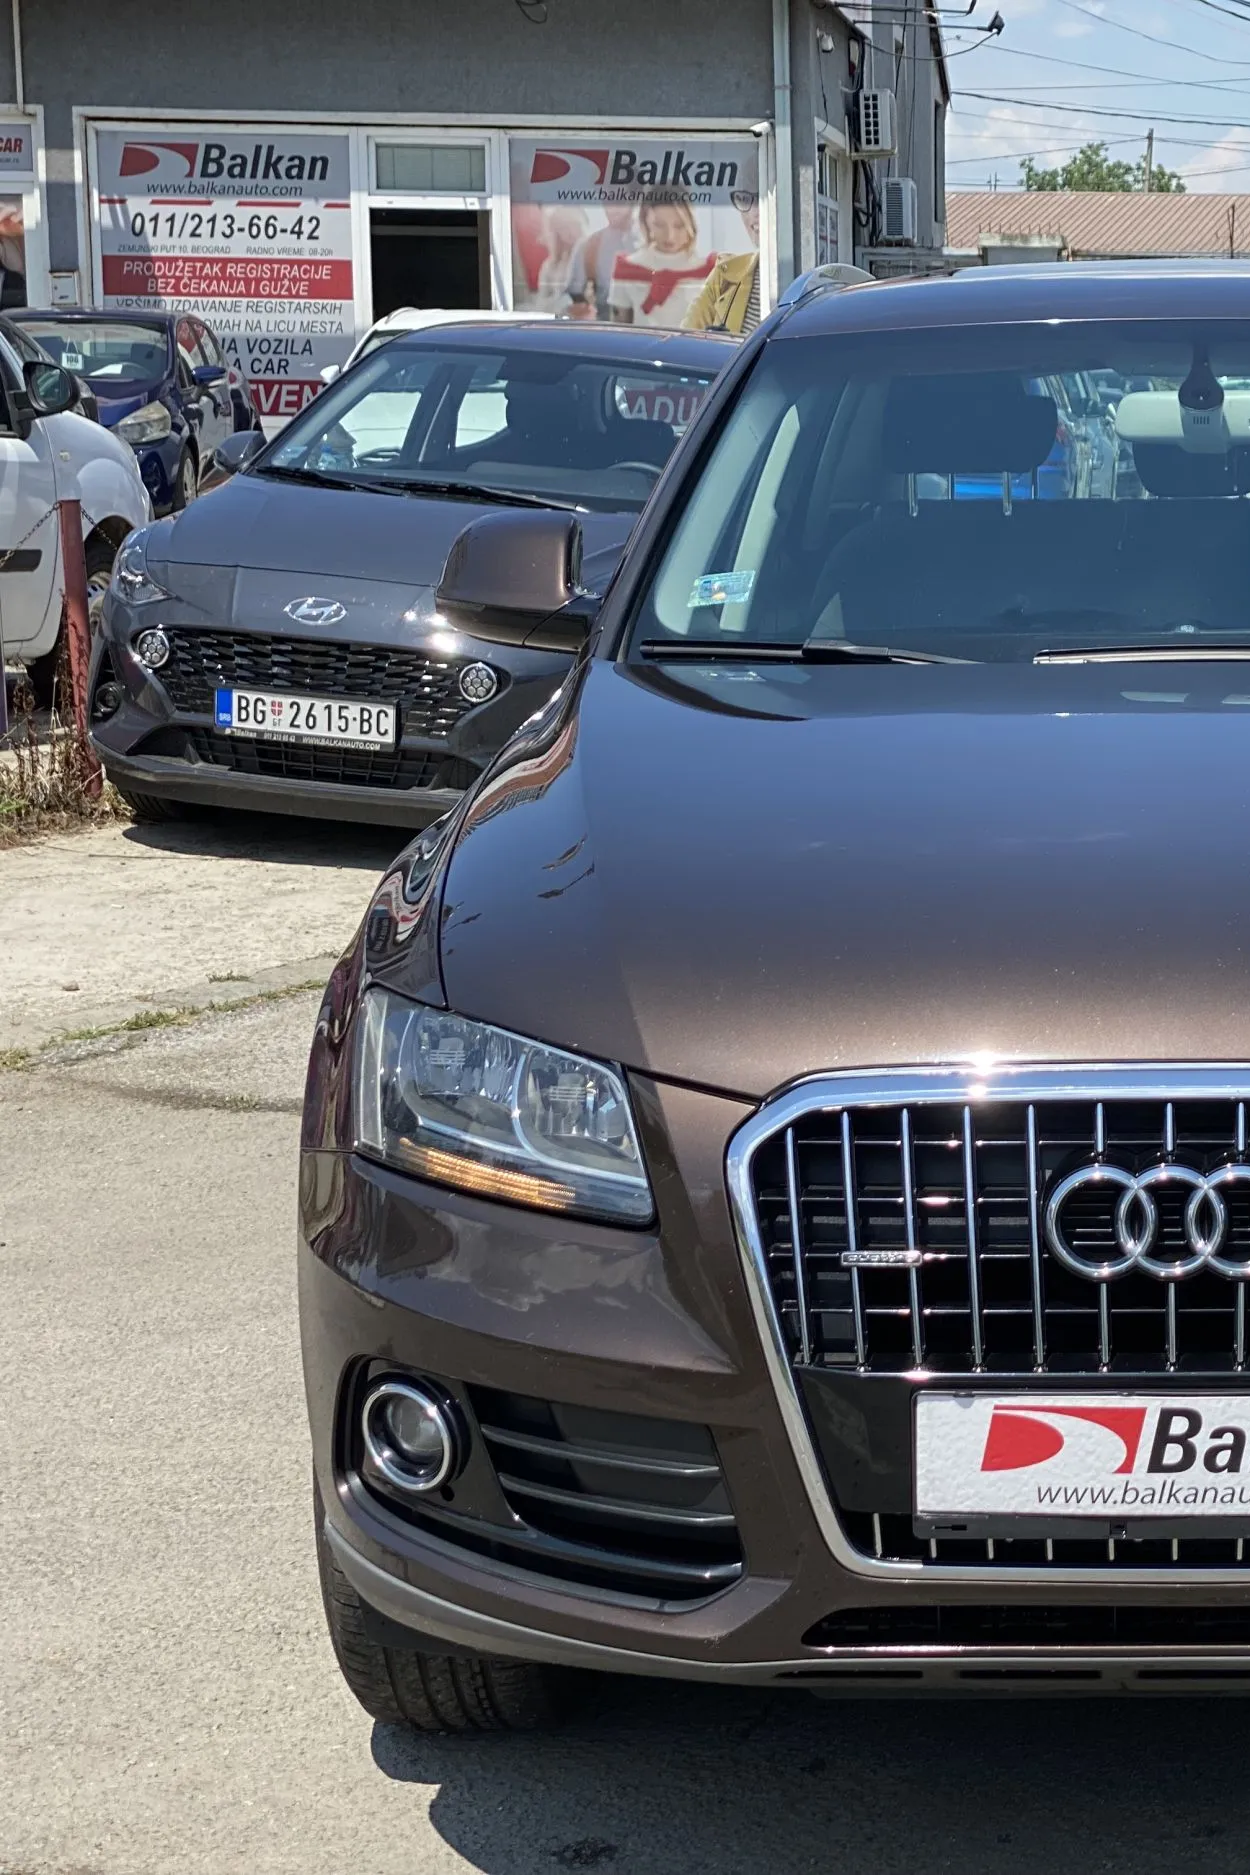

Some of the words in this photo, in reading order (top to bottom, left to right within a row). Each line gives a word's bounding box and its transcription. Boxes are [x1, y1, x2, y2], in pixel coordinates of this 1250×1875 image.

[200, 143, 330, 181] Balkan
[610, 150, 738, 187] Balkan
[146, 181, 303, 197] www.balkanauto.com
[557, 187, 712, 204] www.balkanauto.com
[131, 212, 321, 241] 011/213-66-42
[160, 244, 178, 253] PUT
[190, 245, 231, 255] BEOGRAD
[246, 247, 275, 256] RADNO
[123, 260, 223, 278] PRODUŽETAK
[226, 263, 332, 280] REGISTRACIJE
[147, 278, 175, 293] BEZ
[179, 274, 246, 295] ČEKANJA
[250, 281, 255, 294] I
[260, 277, 309, 296] GUŽVE
[171, 299, 243, 315] IZDAVANJE
[246, 301, 344, 316] REGISTARSKIH
[244, 320, 266, 333] NA
[266, 320, 296, 333] LICU
[300, 321, 344, 334] MESTA
[247, 338, 313, 356] VOZILA
[250, 358, 290, 375] CAR
[237, 694, 267, 725] BG
[302, 736, 381, 750] WWW.BALKANAUTO.COM
